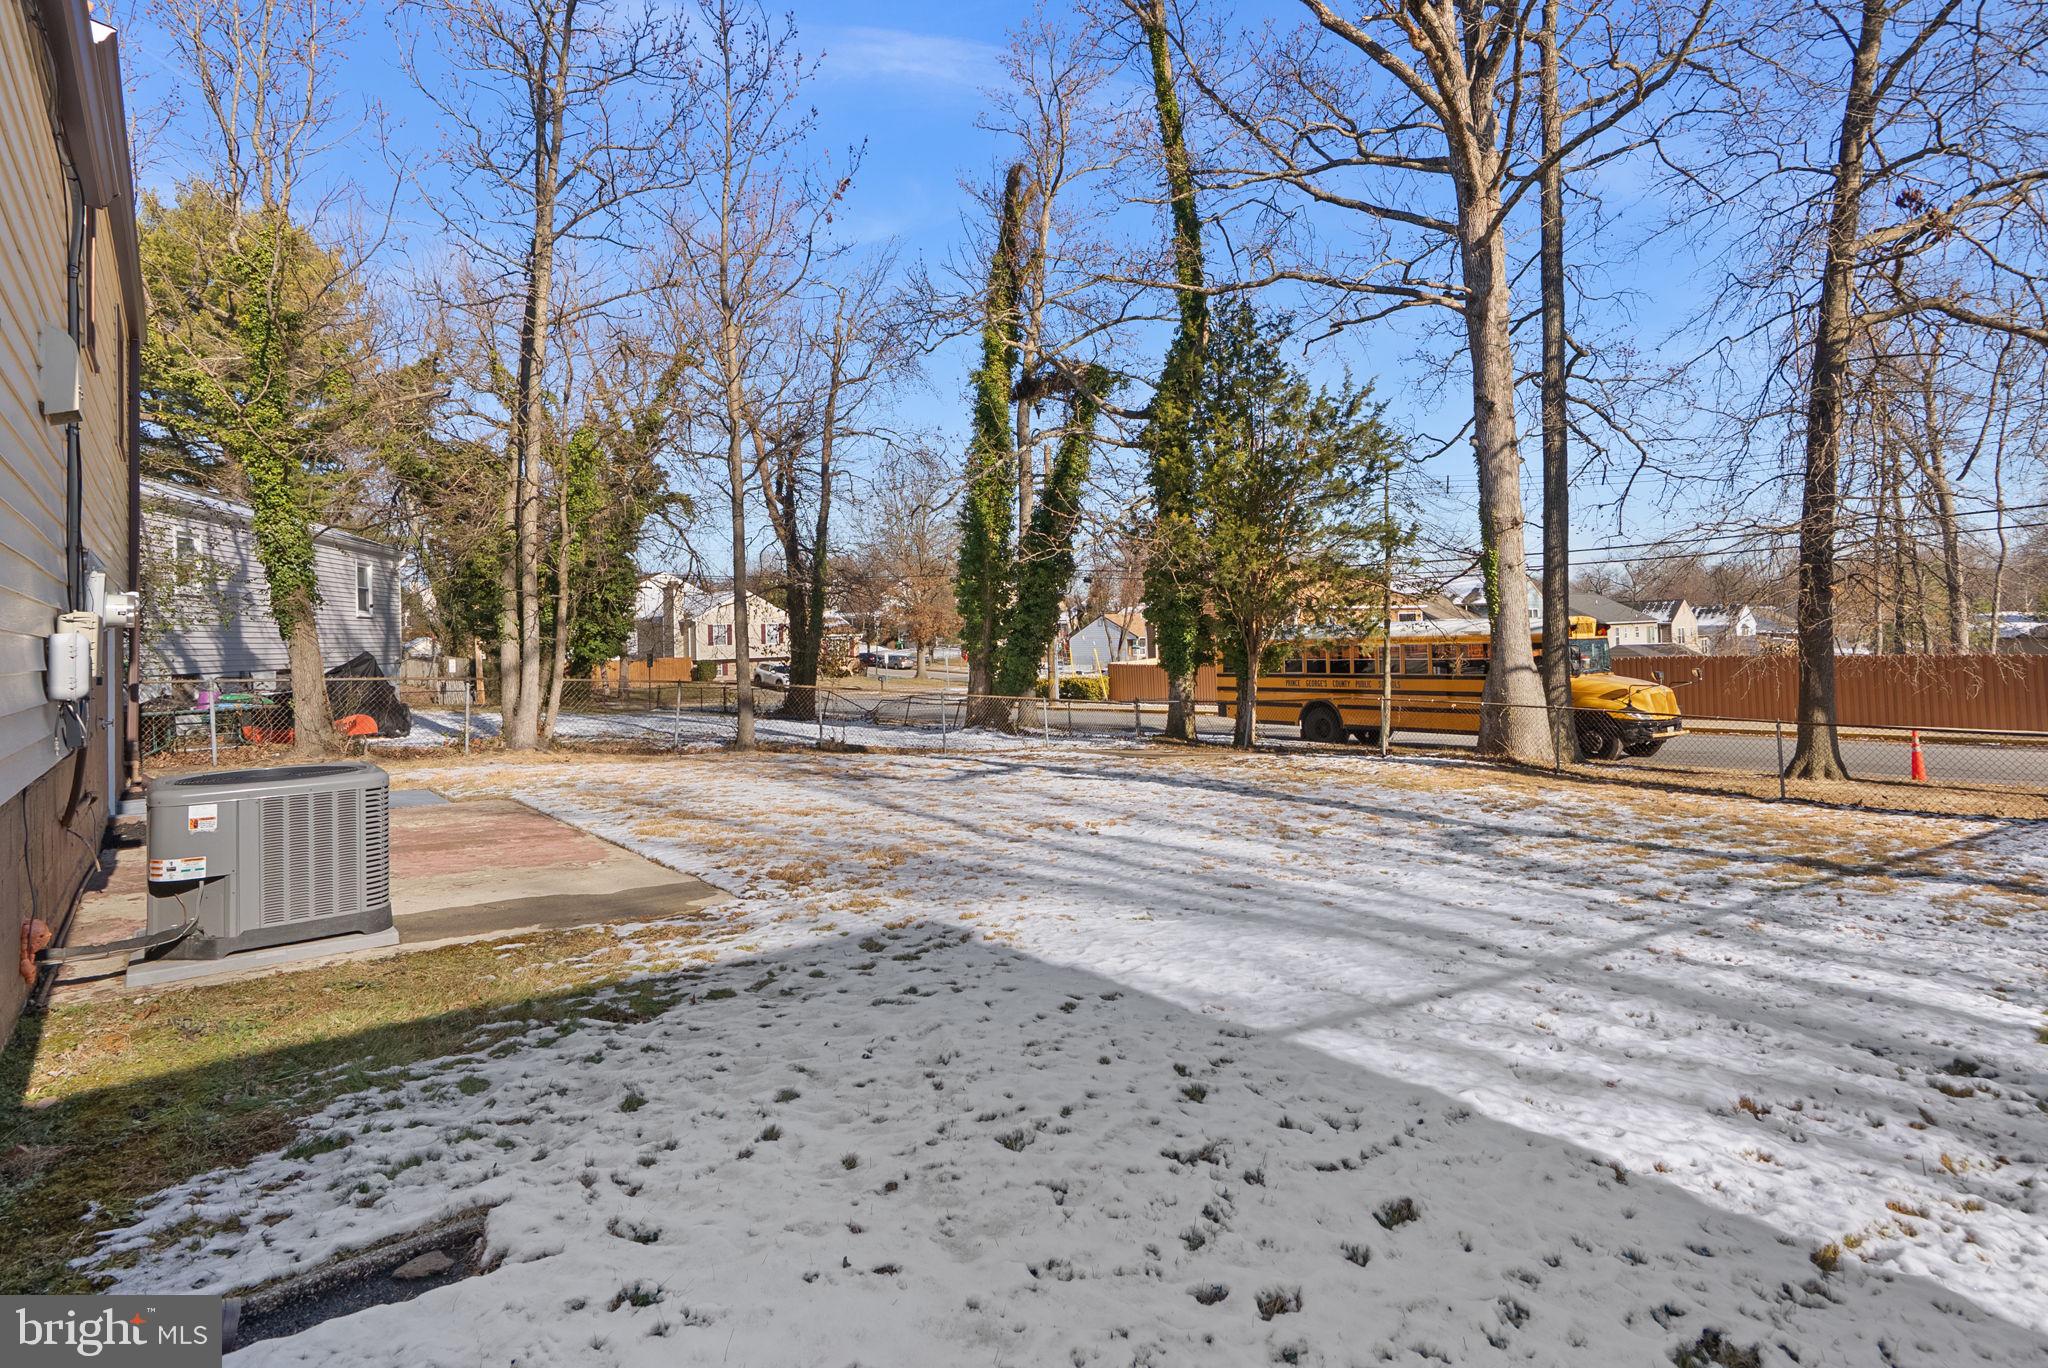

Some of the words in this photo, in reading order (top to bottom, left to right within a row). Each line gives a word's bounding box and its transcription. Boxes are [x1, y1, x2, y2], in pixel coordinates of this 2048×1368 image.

[1285, 679, 1300, 687] PRINCE
[1332, 680, 1350, 688] COUNTY
[1355, 680, 1372, 688] PUBLIC
